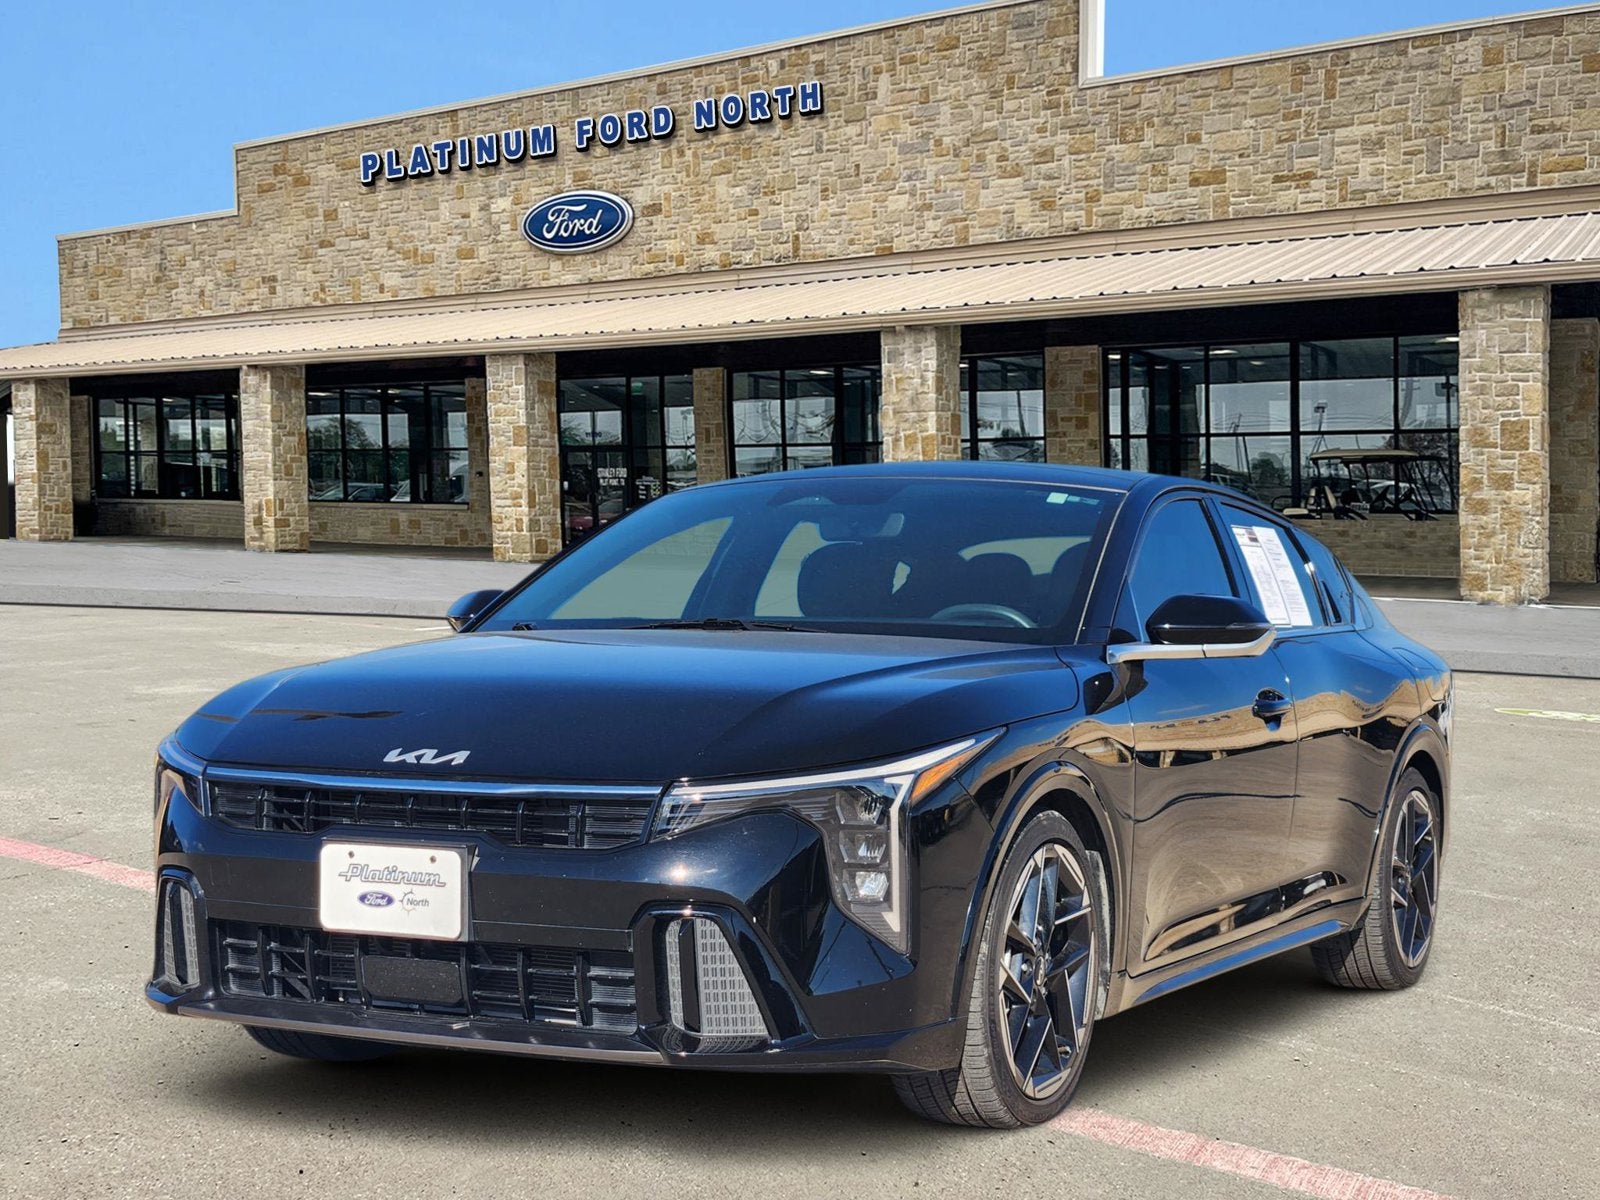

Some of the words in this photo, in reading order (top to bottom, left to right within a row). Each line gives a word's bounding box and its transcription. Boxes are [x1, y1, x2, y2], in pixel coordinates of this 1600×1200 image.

[360, 124, 557, 186] PLATINUM
[576, 105, 676, 151] FORD
[693, 81, 823, 133] NORTH
[542, 203, 602, 239] Ford
[338, 863, 447, 887] Platinum
[364, 892, 389, 906] Ford
[406, 897, 430, 907] North
